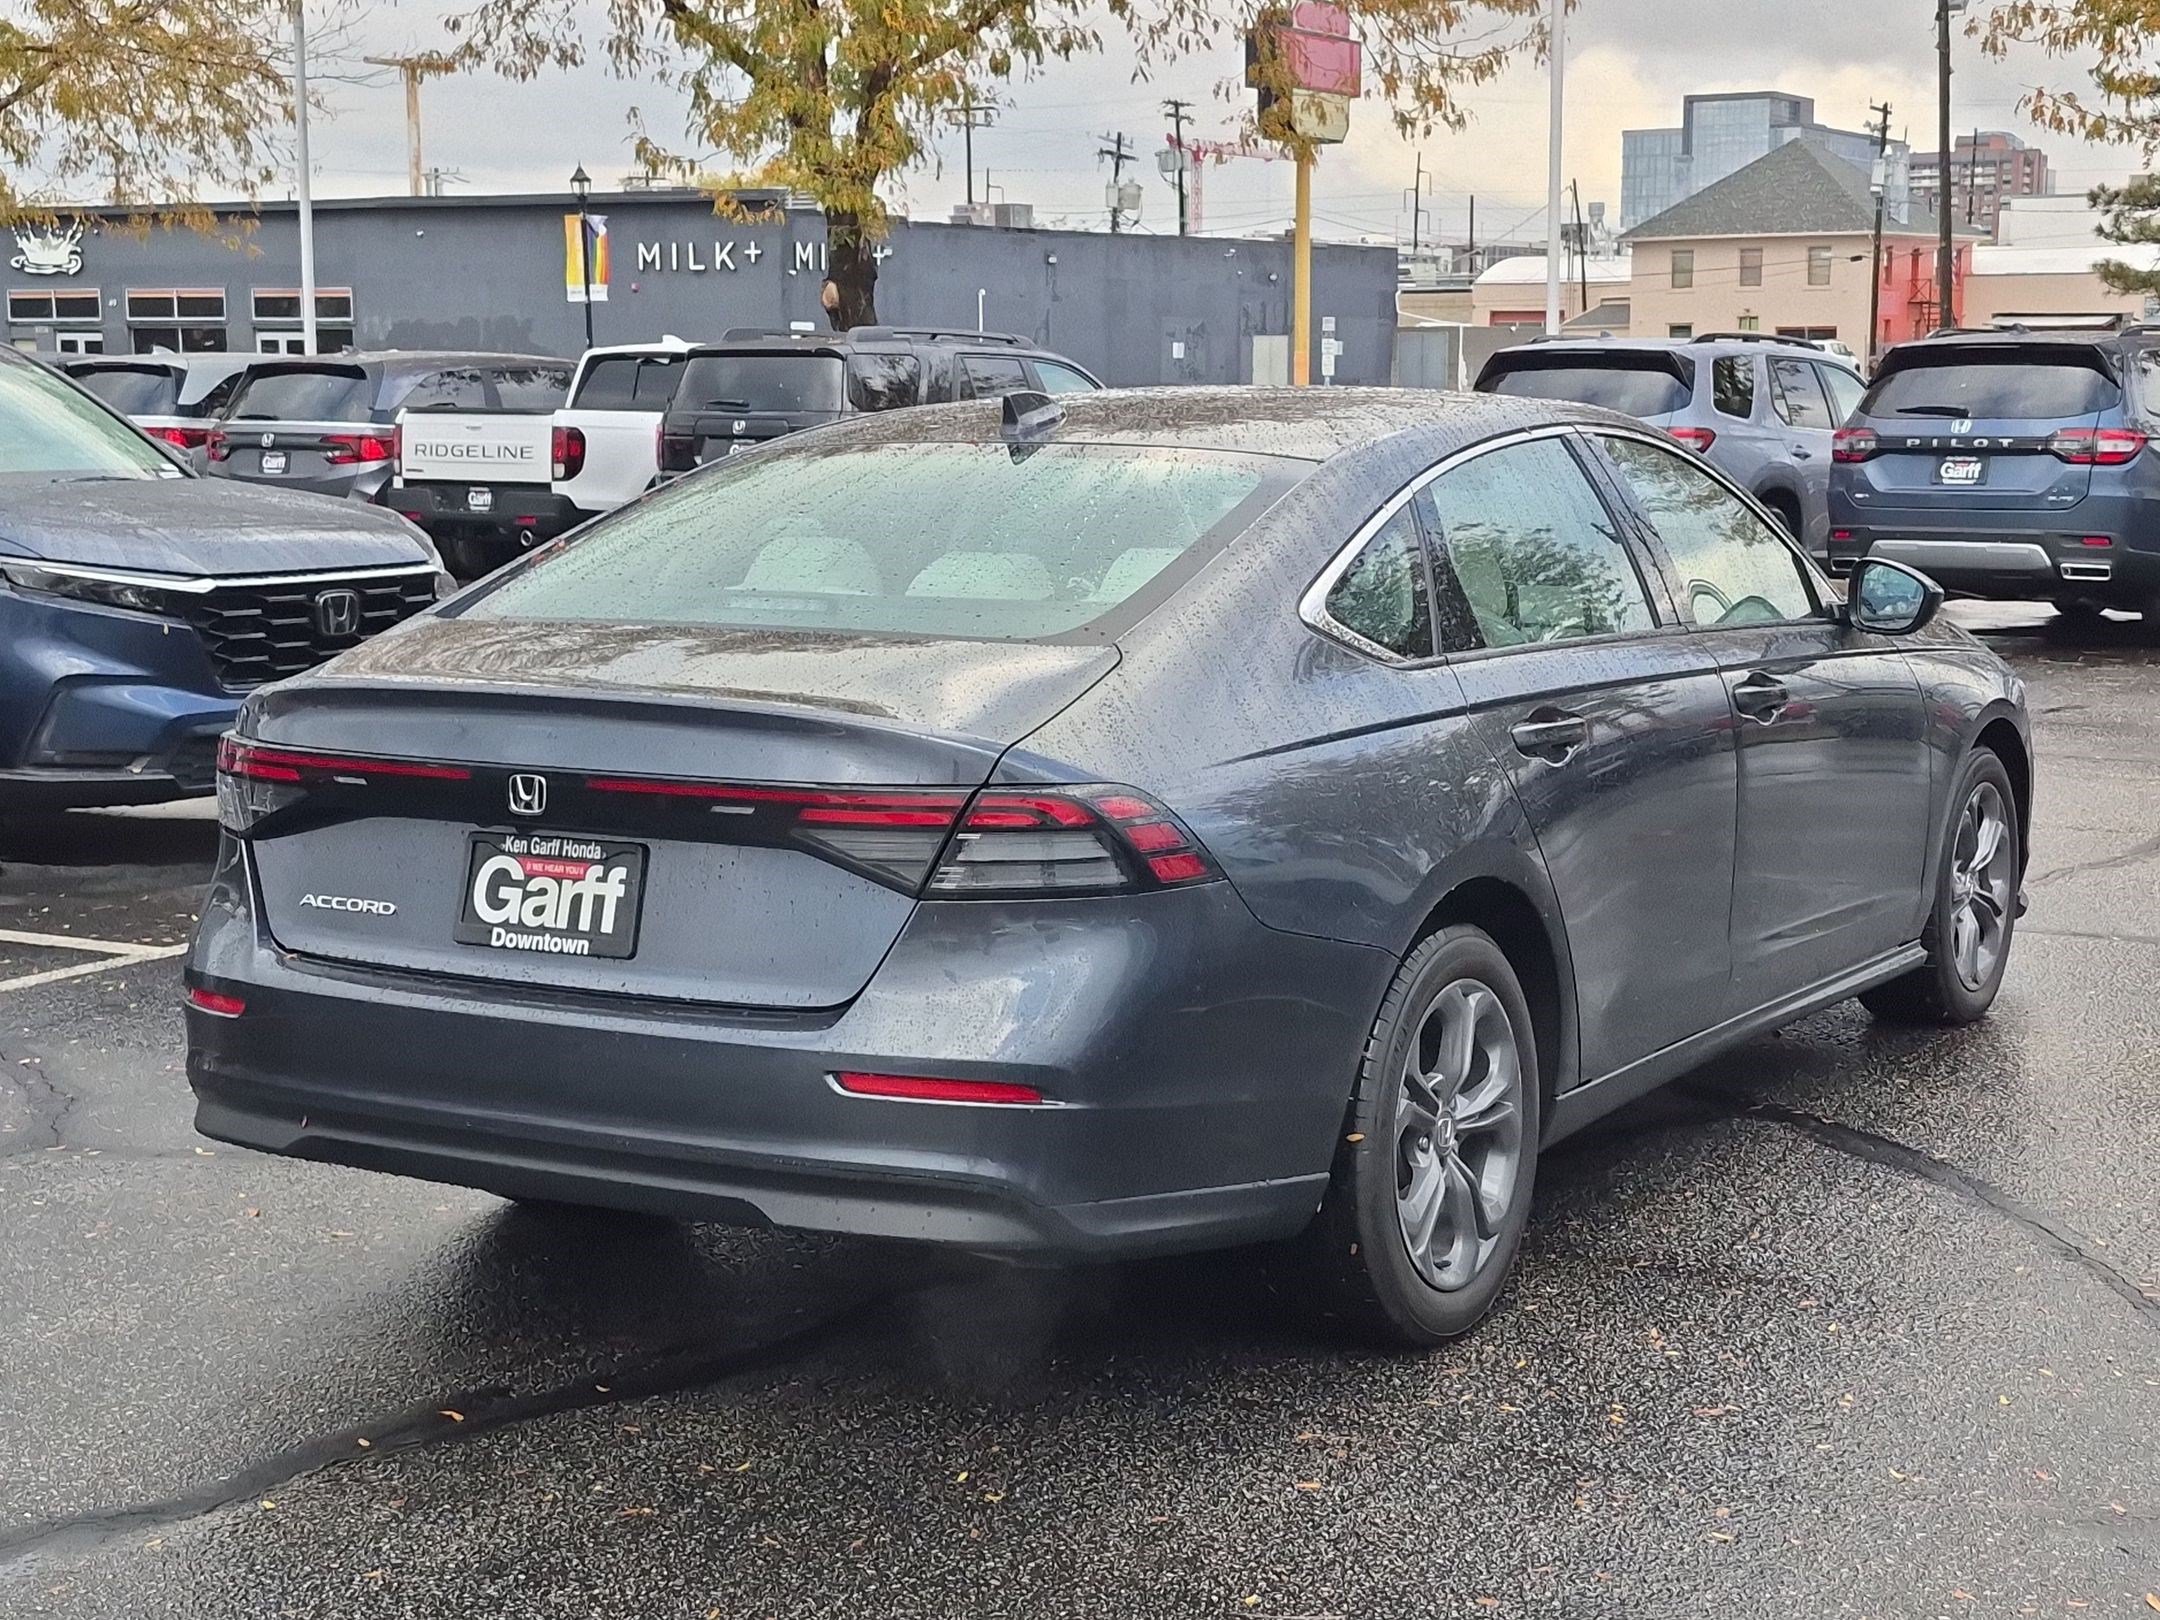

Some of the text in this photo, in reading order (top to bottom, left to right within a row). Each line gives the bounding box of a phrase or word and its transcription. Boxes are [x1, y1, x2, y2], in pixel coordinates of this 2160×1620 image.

[637, 240, 762, 271] MILK+
[795, 240, 884, 271] MI+
[414, 443, 534, 459] RIDGELINE
[1906, 438, 2014, 448] PILOT
[1940, 462, 1981, 479] Garff
[505, 835, 601, 860] Ken Garff Honda
[532, 863, 544, 872] WE
[544, 864, 564, 873] HEAR
[300, 894, 396, 915] ACCORD
[473, 855, 628, 935] Garff
[491, 927, 590, 955] Downtown
